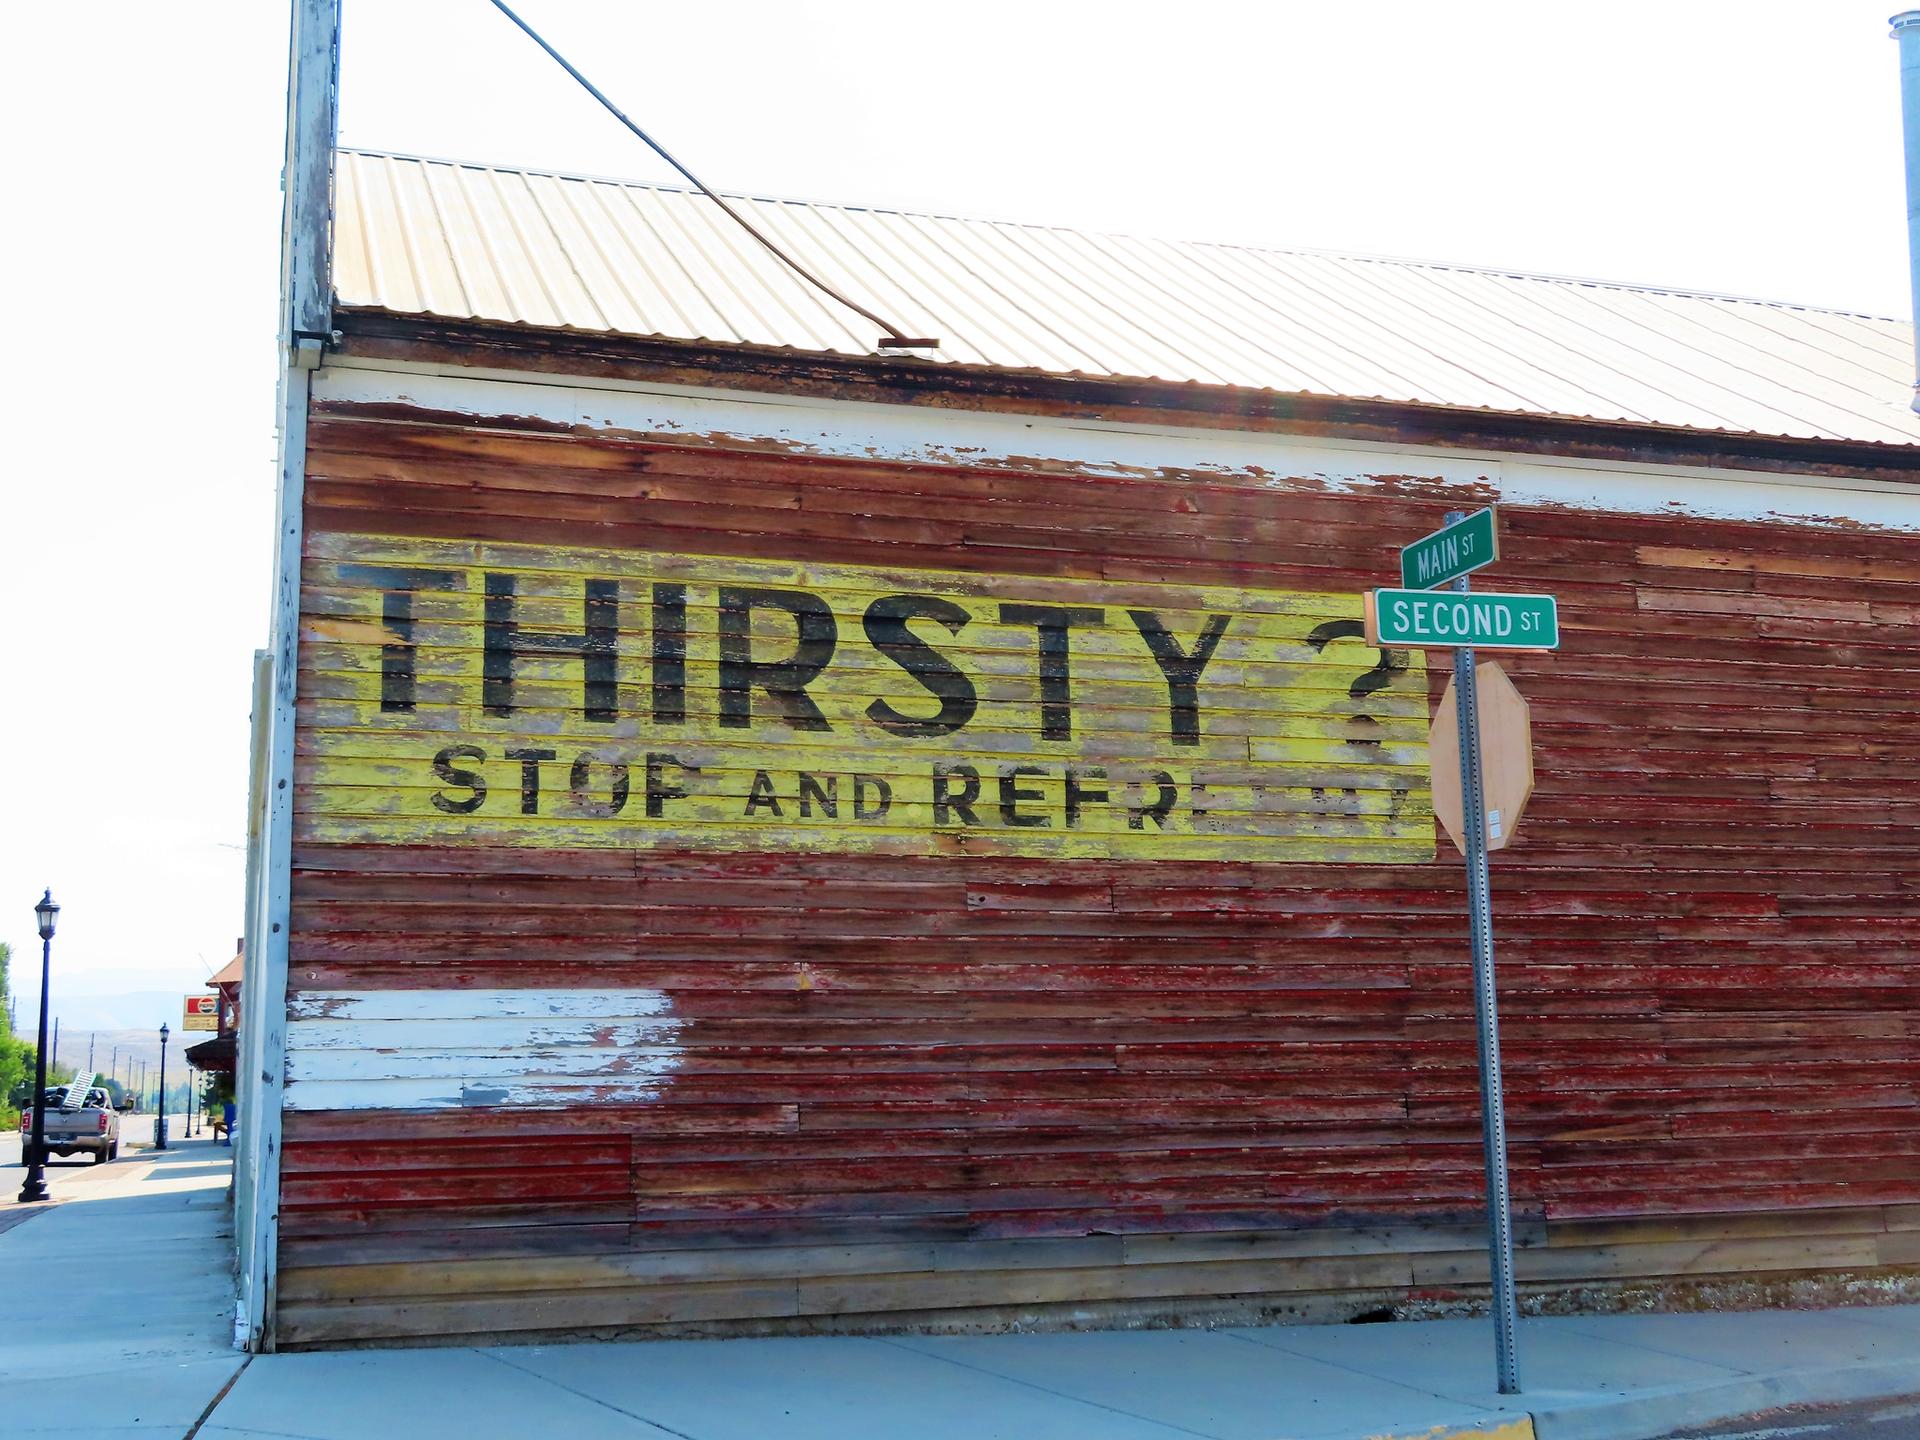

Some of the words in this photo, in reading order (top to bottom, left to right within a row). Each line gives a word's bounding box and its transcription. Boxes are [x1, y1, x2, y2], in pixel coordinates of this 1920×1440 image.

[1417, 535, 1459, 583] MAIN
[1462, 532, 1475, 555] ST
[1393, 600, 1512, 637] SECOND
[1520, 611, 1541, 631] ST
[430, 744, 699, 818] STOP
[743, 769, 892, 822] AND
